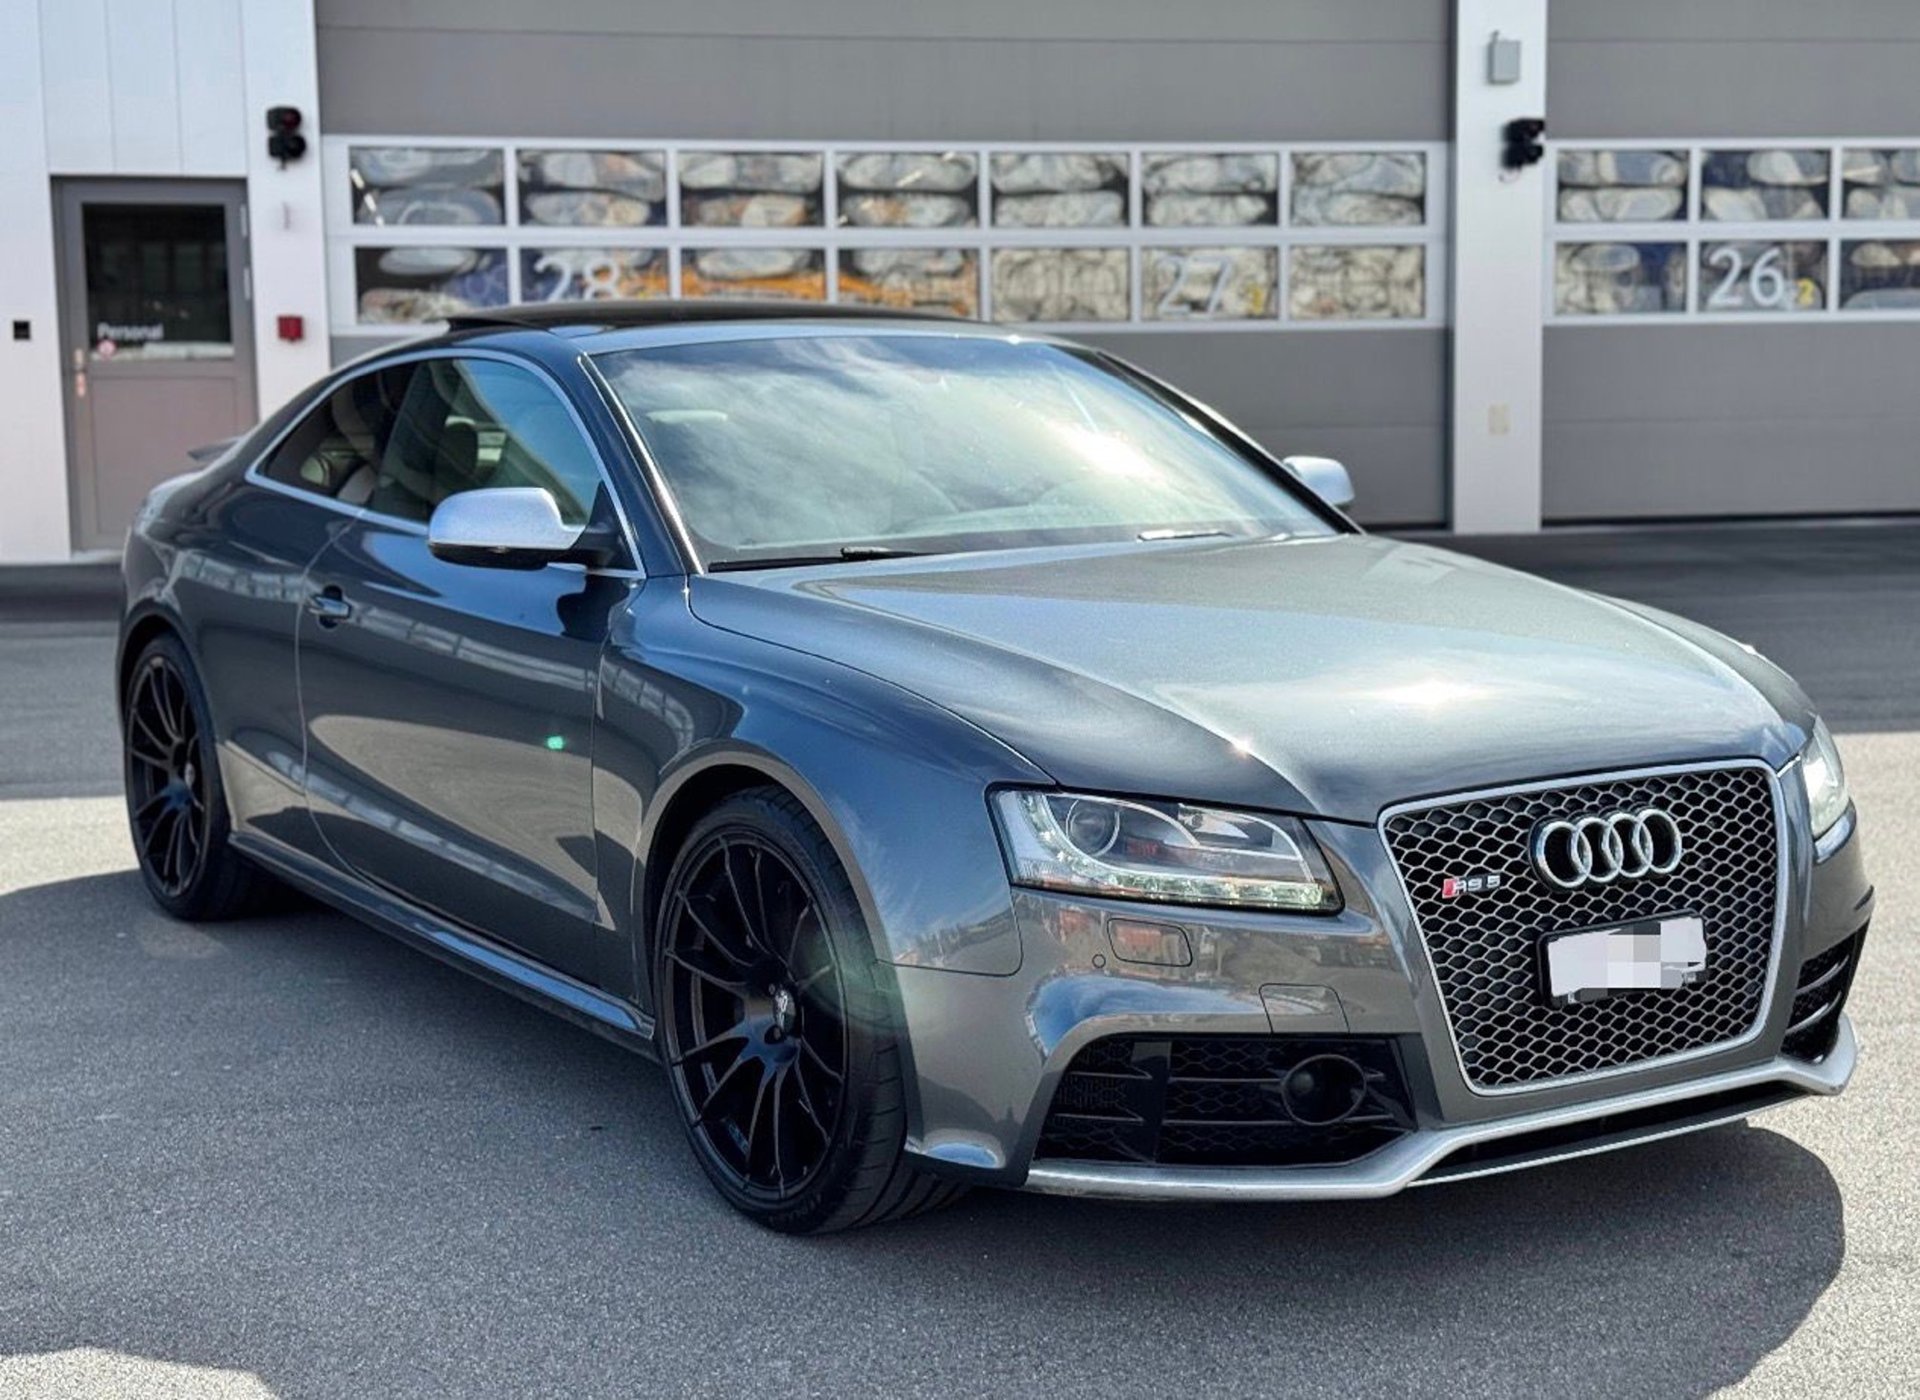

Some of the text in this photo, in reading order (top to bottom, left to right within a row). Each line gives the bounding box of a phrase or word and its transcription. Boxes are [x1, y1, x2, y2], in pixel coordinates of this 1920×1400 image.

[534, 257, 619, 301] 28
[1158, 255, 1231, 316] 27
[1709, 247, 1784, 306] 26
[97, 322, 163, 341] Personal
